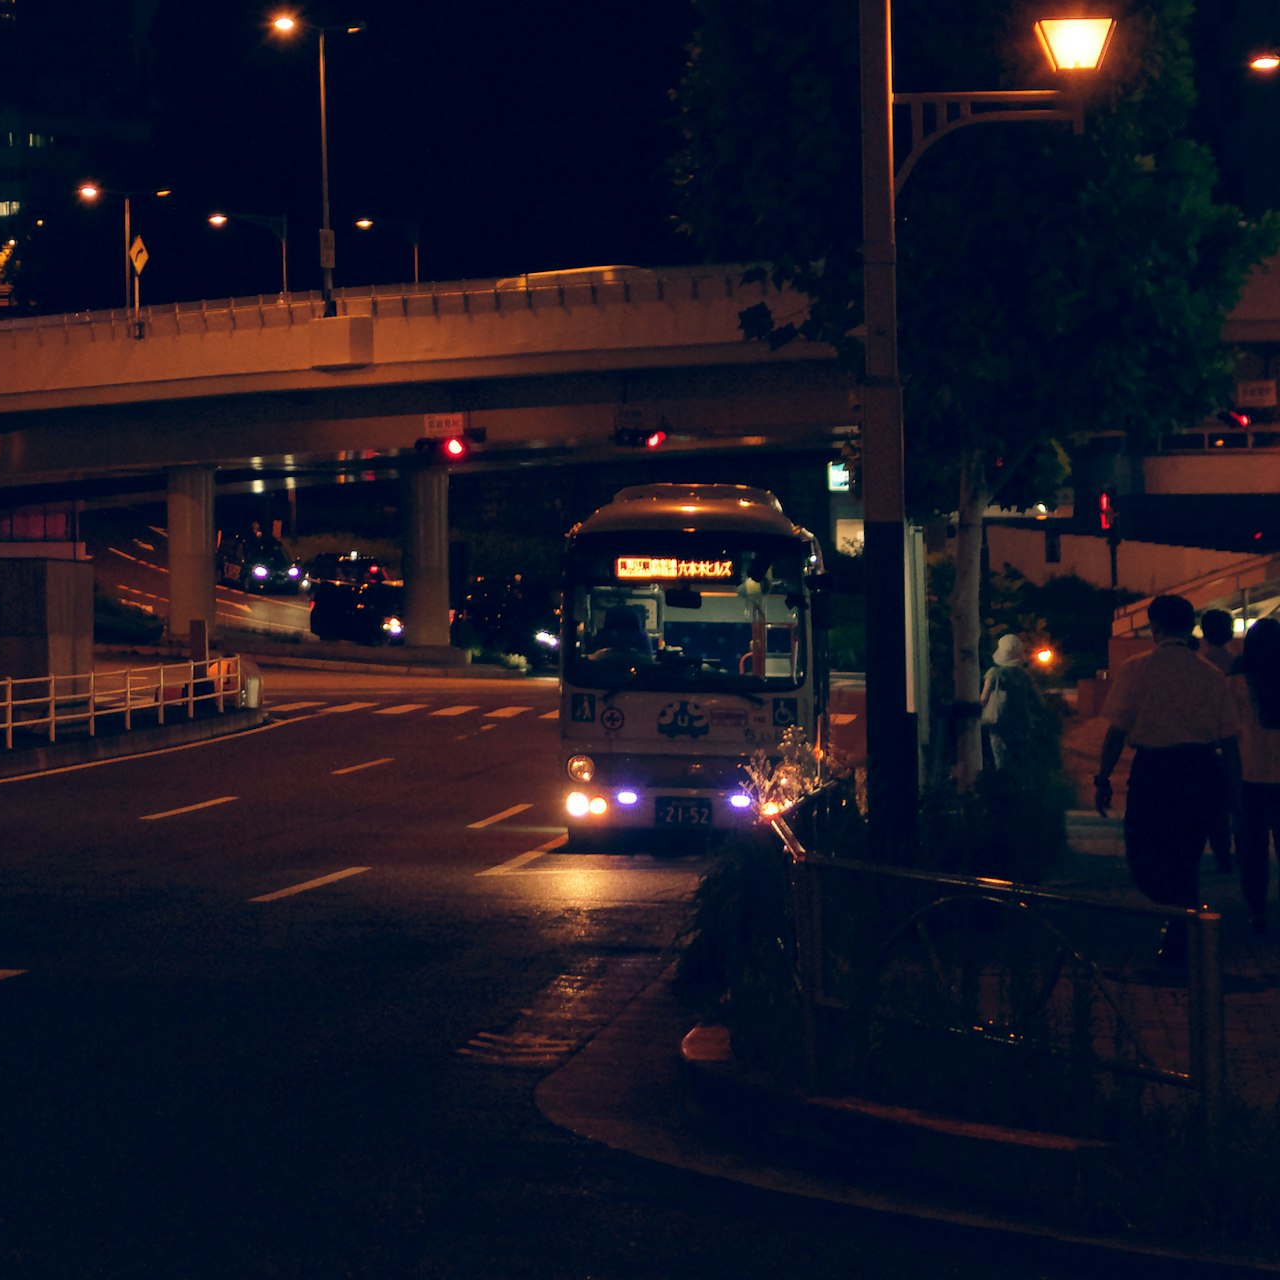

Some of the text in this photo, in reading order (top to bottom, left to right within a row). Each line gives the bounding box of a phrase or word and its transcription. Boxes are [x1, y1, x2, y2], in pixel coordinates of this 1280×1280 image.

[678, 560, 732, 577] 六本木ヒルズ
